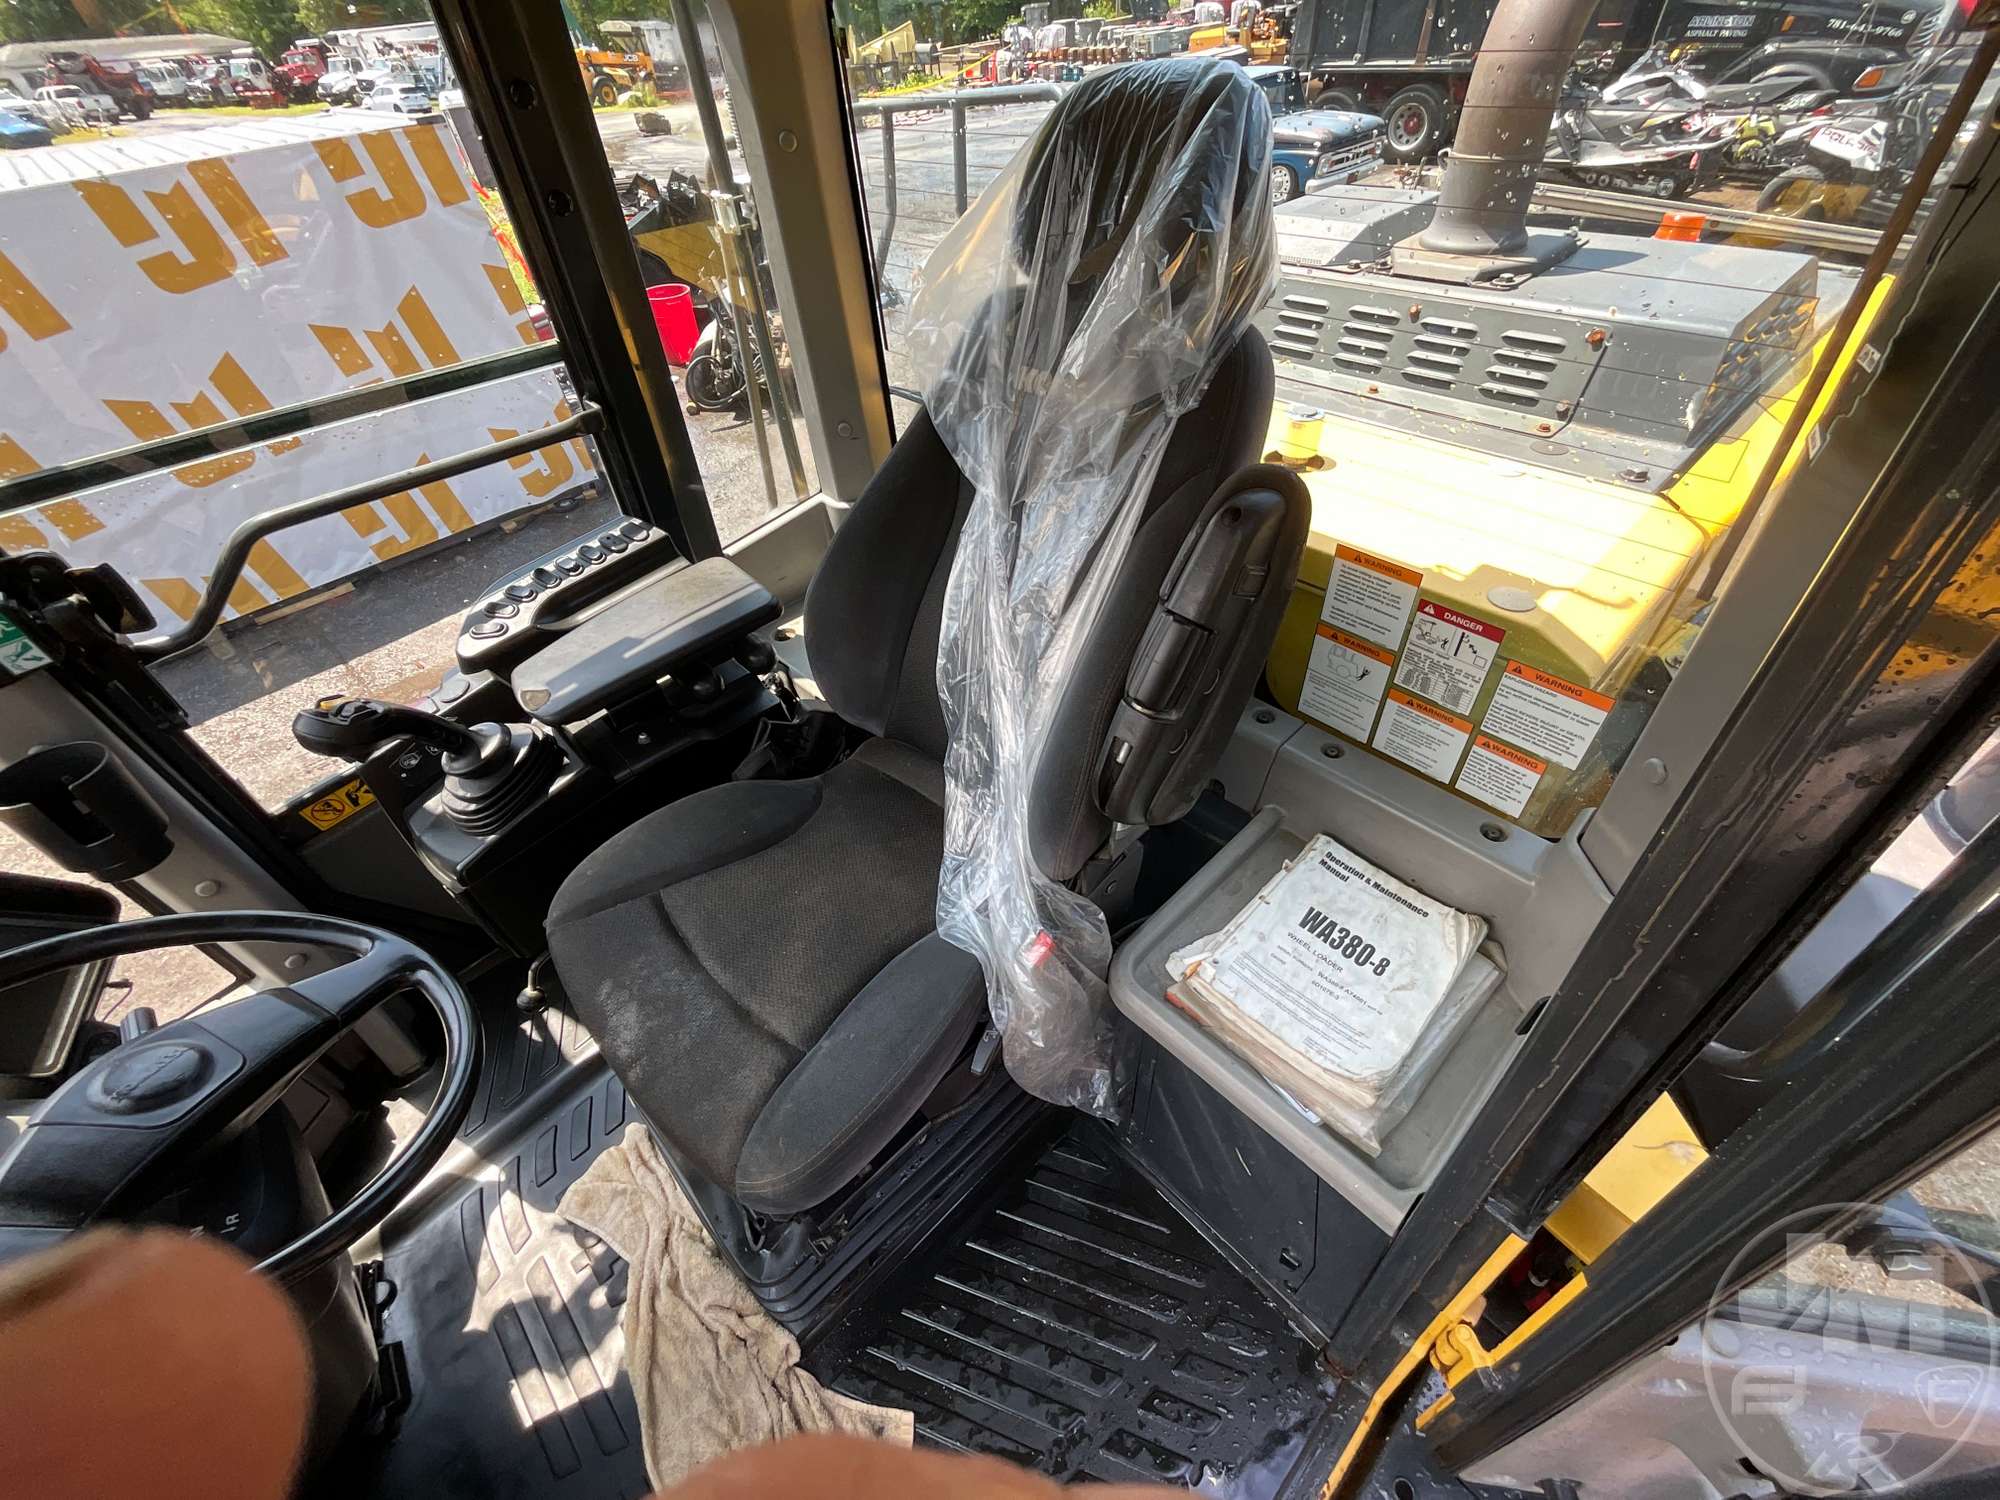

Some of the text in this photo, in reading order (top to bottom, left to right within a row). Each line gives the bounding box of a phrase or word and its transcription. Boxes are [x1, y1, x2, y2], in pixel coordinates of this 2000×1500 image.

[1687, 15, 1756, 27] ARLINGTON
[1684, 29, 1748, 37] ASPHALT PAVING
[1363, 556, 1402, 577] WARNING
[1443, 611, 1483, 633] DANGER
[1343, 637, 1380, 658] WARNING
[1534, 672, 1584, 698] WARNING
[1415, 702, 1454, 724] WARNING
[1491, 744, 1538, 769] WARNING
[1317, 857, 1350, 883] Manual
[1324, 850, 1429, 919] Operation & Maintenance
[1287, 931, 1313, 952] WHEEL
[1312, 949, 1344, 973] LOADER
[1297, 905, 1391, 978] WA380-8
